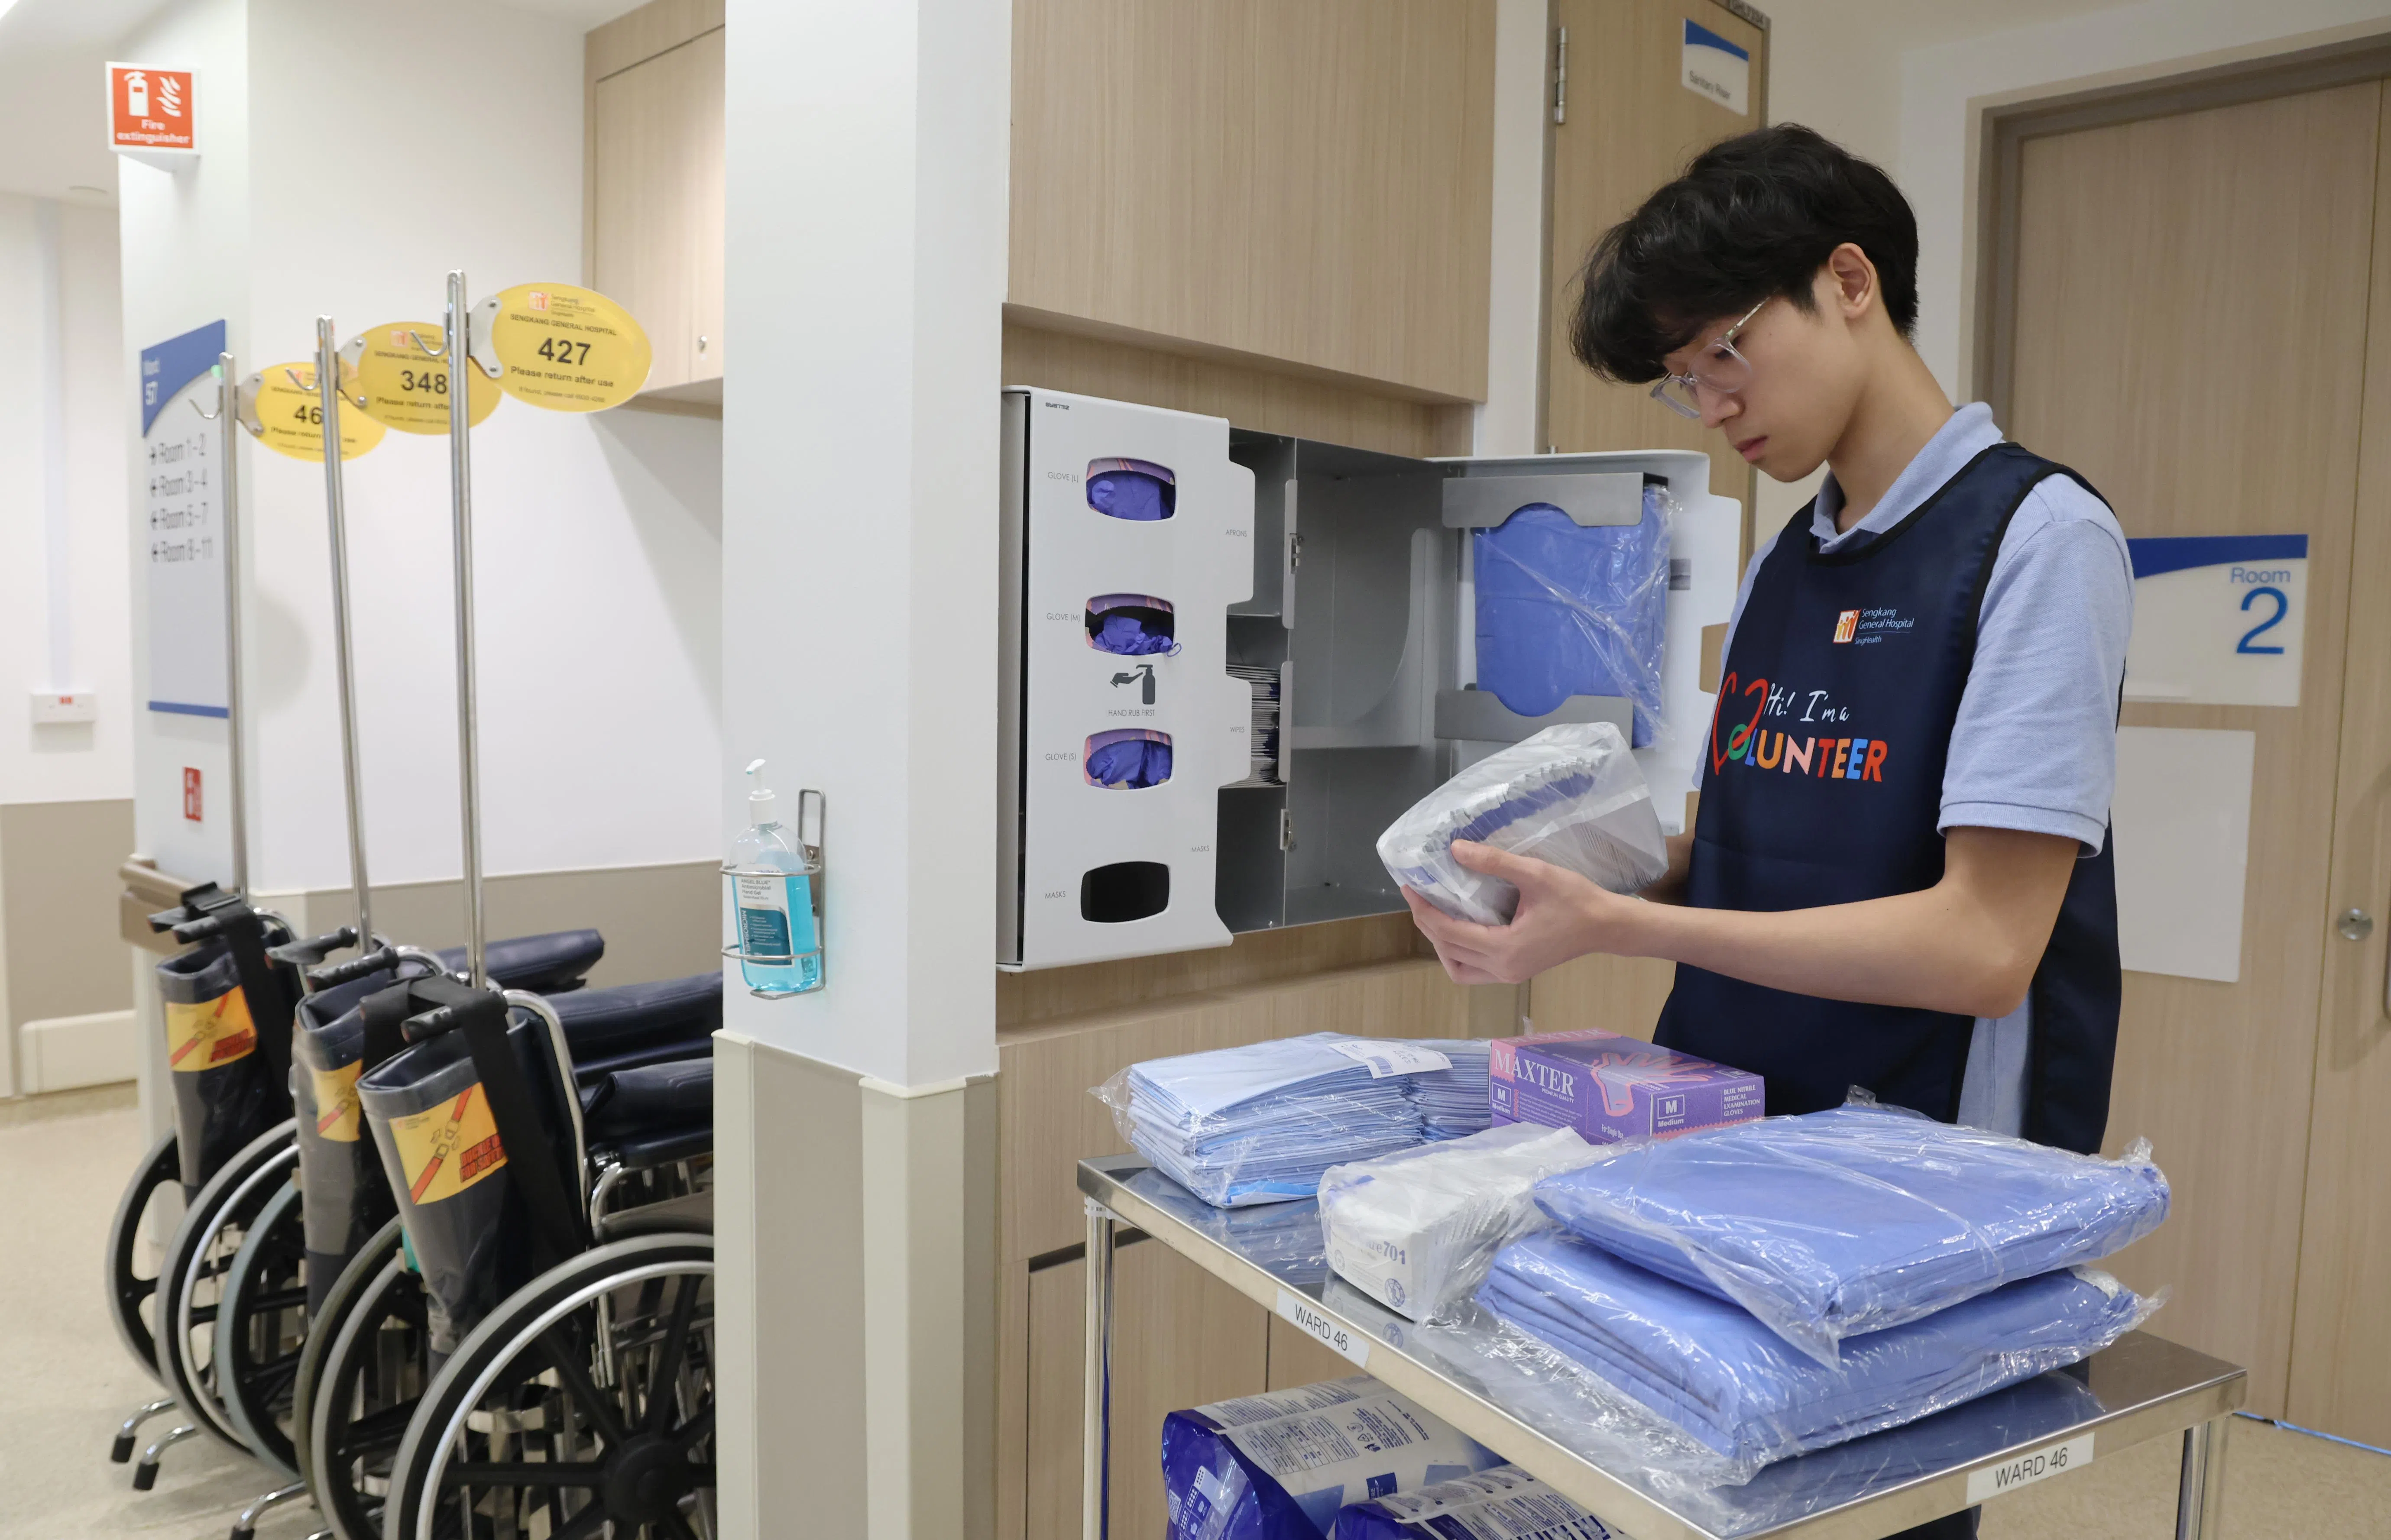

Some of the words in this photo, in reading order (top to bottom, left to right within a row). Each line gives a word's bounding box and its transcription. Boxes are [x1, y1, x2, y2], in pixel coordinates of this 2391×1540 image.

[141, 119, 165, 130] Fire
[117, 132, 190, 144] extinguisher
[510, 314, 549, 325] SENGKANG
[551, 320, 583, 330] GENERAL
[584, 325, 616, 336] HOSPITAL
[538, 338, 591, 366] 427
[401, 370, 447, 395] 348
[511, 366, 541, 378] Please
[544, 372, 572, 382] return
[575, 375, 595, 385] after
[294, 405, 324, 425] 46
[159, 442, 185, 464] Room
[1047, 471, 1069, 481] GLOVE
[1071, 474, 1079, 482] (L)
[159, 475, 184, 496] Room
[160, 508, 185, 528] Room
[1225, 529, 1247, 537] APRONS
[161, 541, 185, 562] Room
[2230, 566, 2291, 583] Room
[1046, 612, 1069, 621] GLOVE
[1070, 613, 1080, 623] (M)
[1862, 608, 1897, 618] Sengkang
[2236, 586, 2288, 654] 2
[1859, 619, 1885, 629] General
[1886, 618, 1915, 629] Hospital
[1855, 635, 1882, 645] SingHealth
[1763, 683, 1795, 716] Hi!
[1839, 707, 1850, 722] a
[1044, 890, 1066, 899] MASKS
[741, 910, 751, 955] MICROSHIEL
[1494, 1048, 1575, 1097] MAXTER
[1497, 1087, 1506, 1101] M
[1542, 1088, 1558, 1099] PREMIUM
[1558, 1094, 1574, 1103] QUALITY
[1737, 1084, 1756, 1093] NITRILE
[1492, 1103, 1510, 1114] Medium
[1666, 1100, 1677, 1114] M
[1724, 1099, 1760, 1110] EXAMINATION
[1658, 1118, 1684, 1127] Medium
[1383, 1241, 1406, 1265] 701
[1295, 1303, 1330, 1339] WARD
[1334, 1331, 1348, 1351] 46
[1996, 1456, 2045, 1488] WARD
[2050, 1447, 2067, 1469] 46
